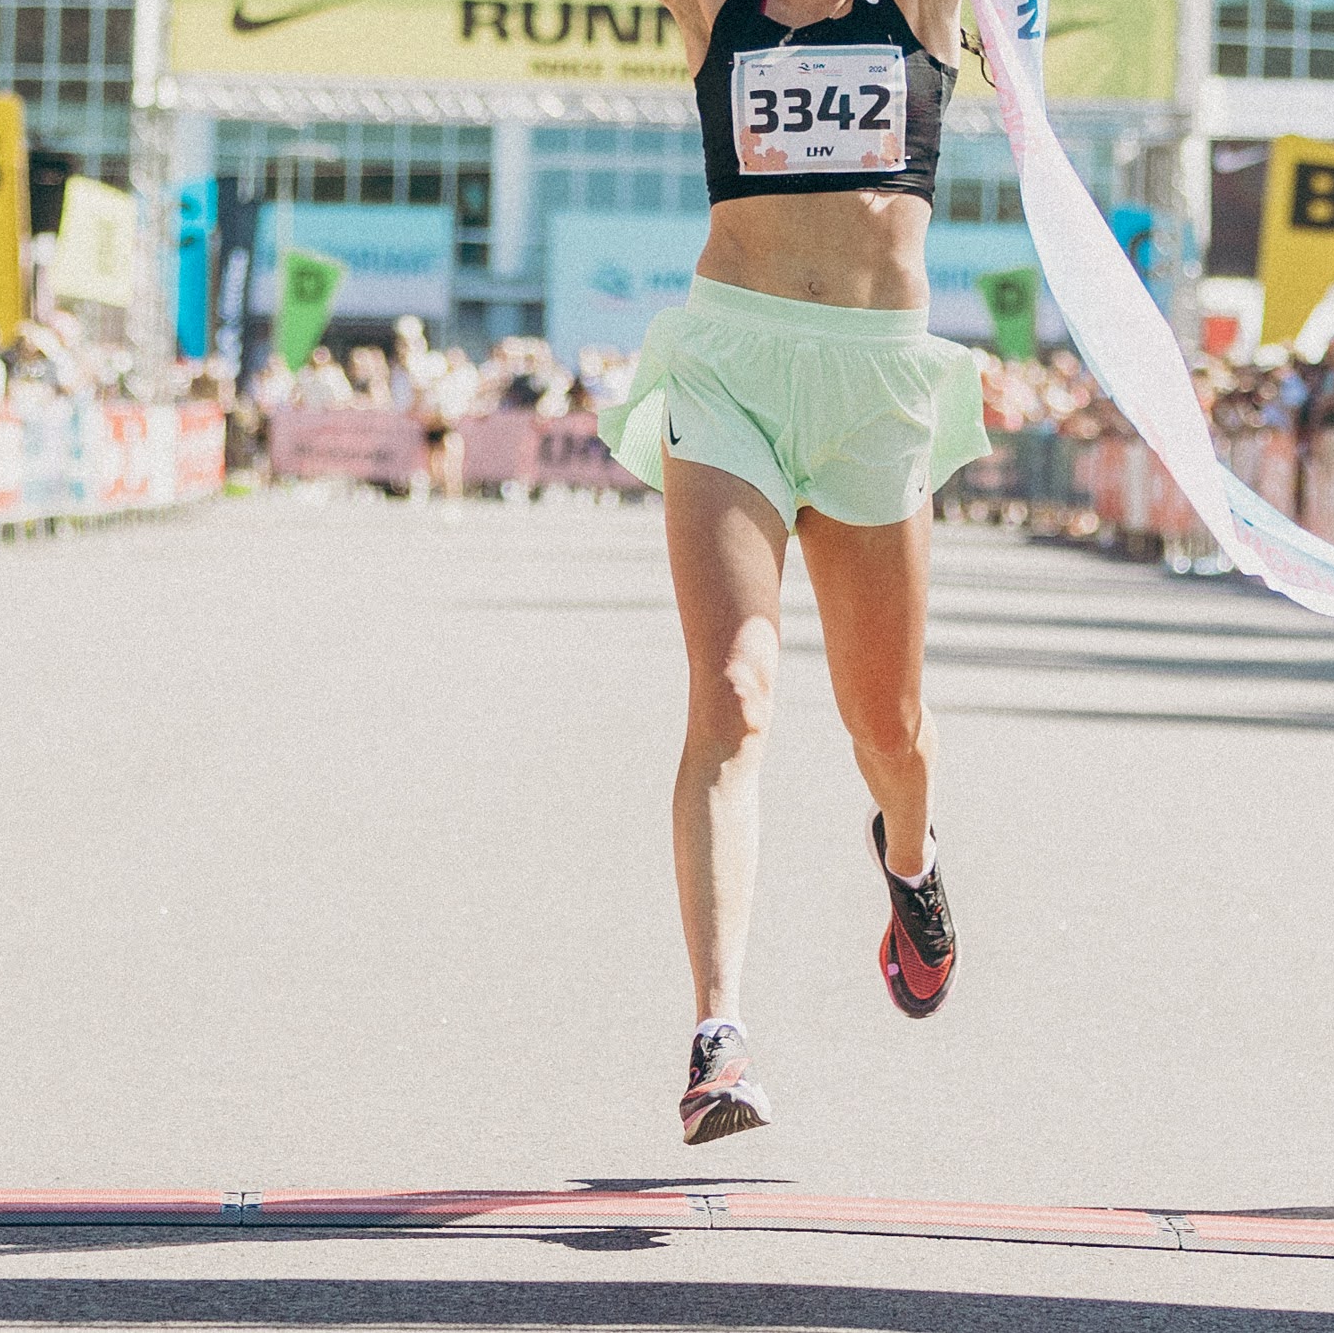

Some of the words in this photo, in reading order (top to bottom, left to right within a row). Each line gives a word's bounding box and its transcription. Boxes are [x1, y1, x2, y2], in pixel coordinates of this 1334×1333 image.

[759, 69, 765, 77] A
[868, 65, 888, 73] 2024
[749, 84, 891, 134] 3342
[806, 146, 834, 157] LHV
